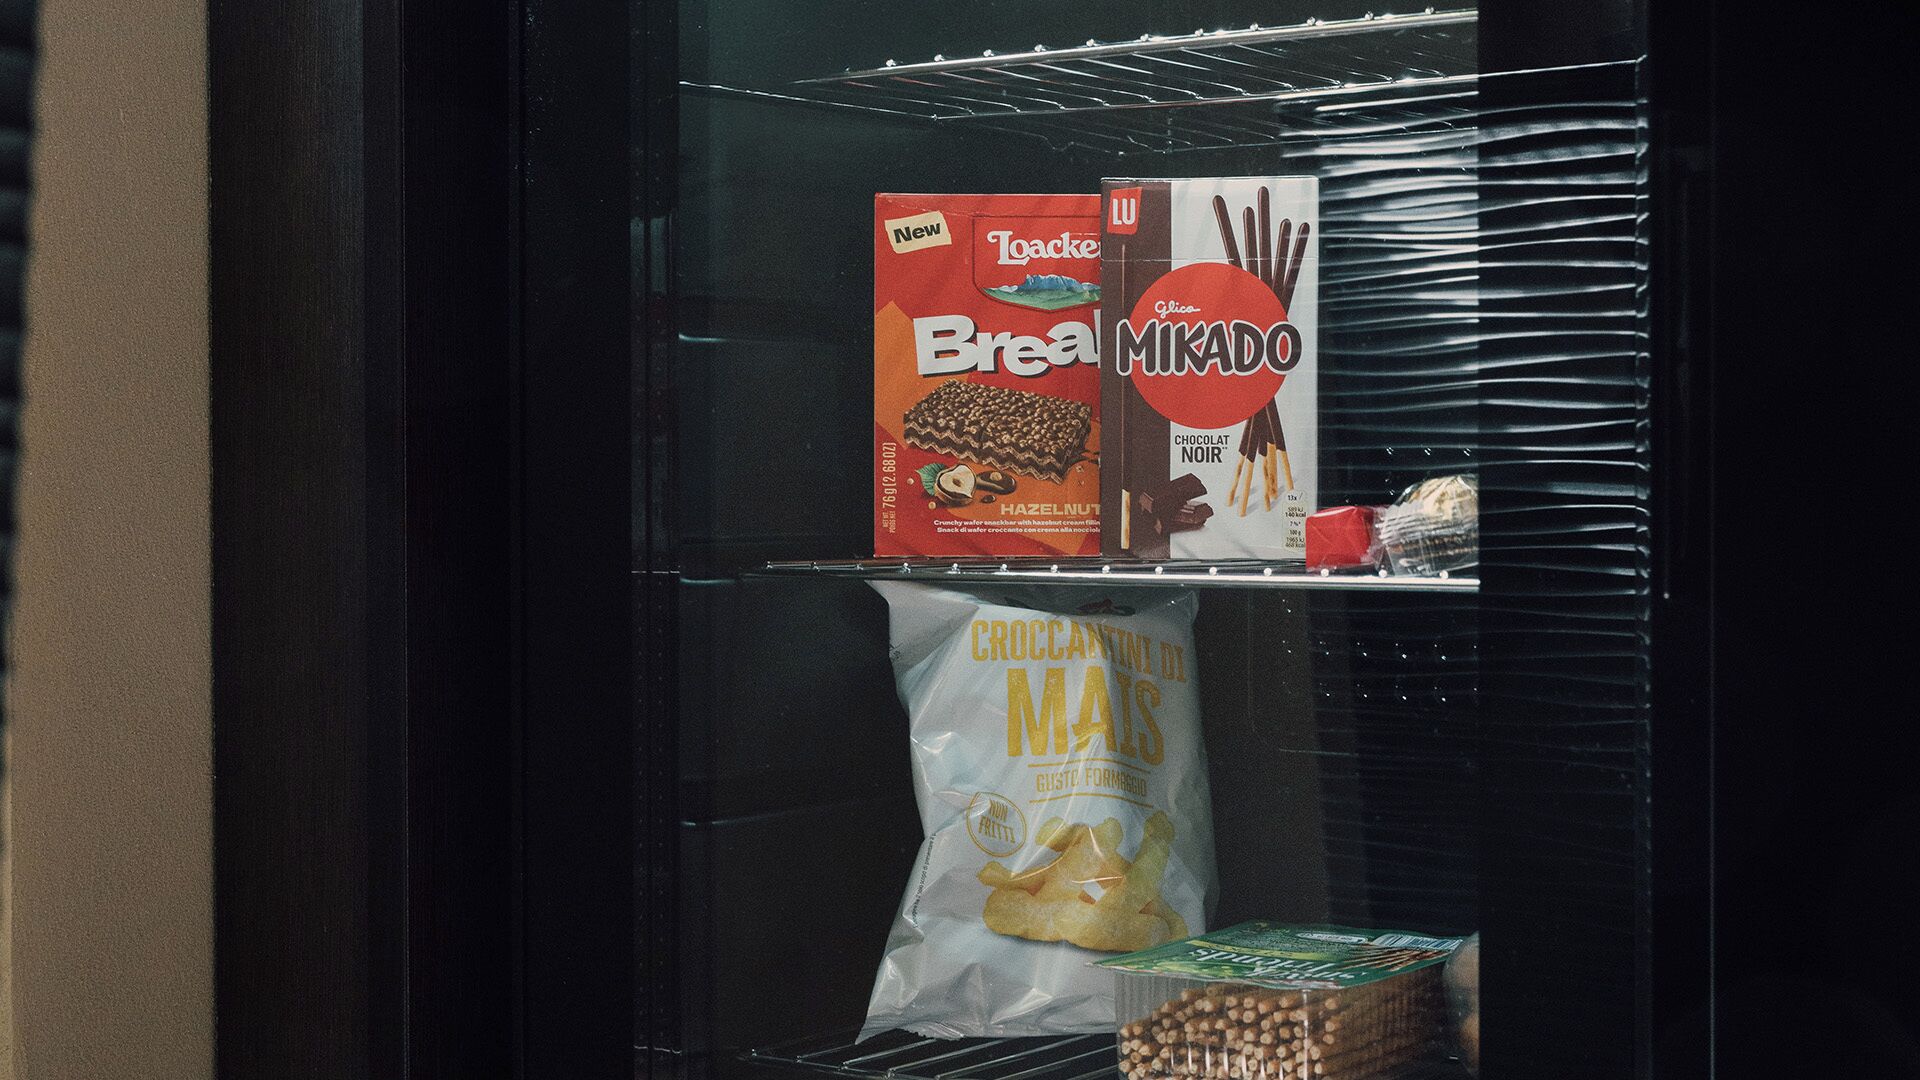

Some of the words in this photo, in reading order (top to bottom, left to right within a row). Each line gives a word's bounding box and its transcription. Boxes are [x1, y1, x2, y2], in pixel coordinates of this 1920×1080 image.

[1111, 198, 1137, 226] LU
[893, 221, 941, 244] New
[987, 230, 1101, 266] Loacke
[913, 309, 1101, 376] Brea
[1115, 318, 1301, 377] MIKADO
[1174, 434, 1230, 445] CHOCOLAT
[1000, 503, 1101, 516] HAZELNUT
[971, 619, 1152, 676] CROCCANTINI
[1160, 641, 1187, 683] DI
[1006, 665, 1165, 767] MAIS
[1036, 768, 1079, 793] GUSTO
[1085, 767, 1147, 797] FORMAGGIO
[988, 799, 1008, 821] NON
[978, 818, 1017, 844] FRITTI
